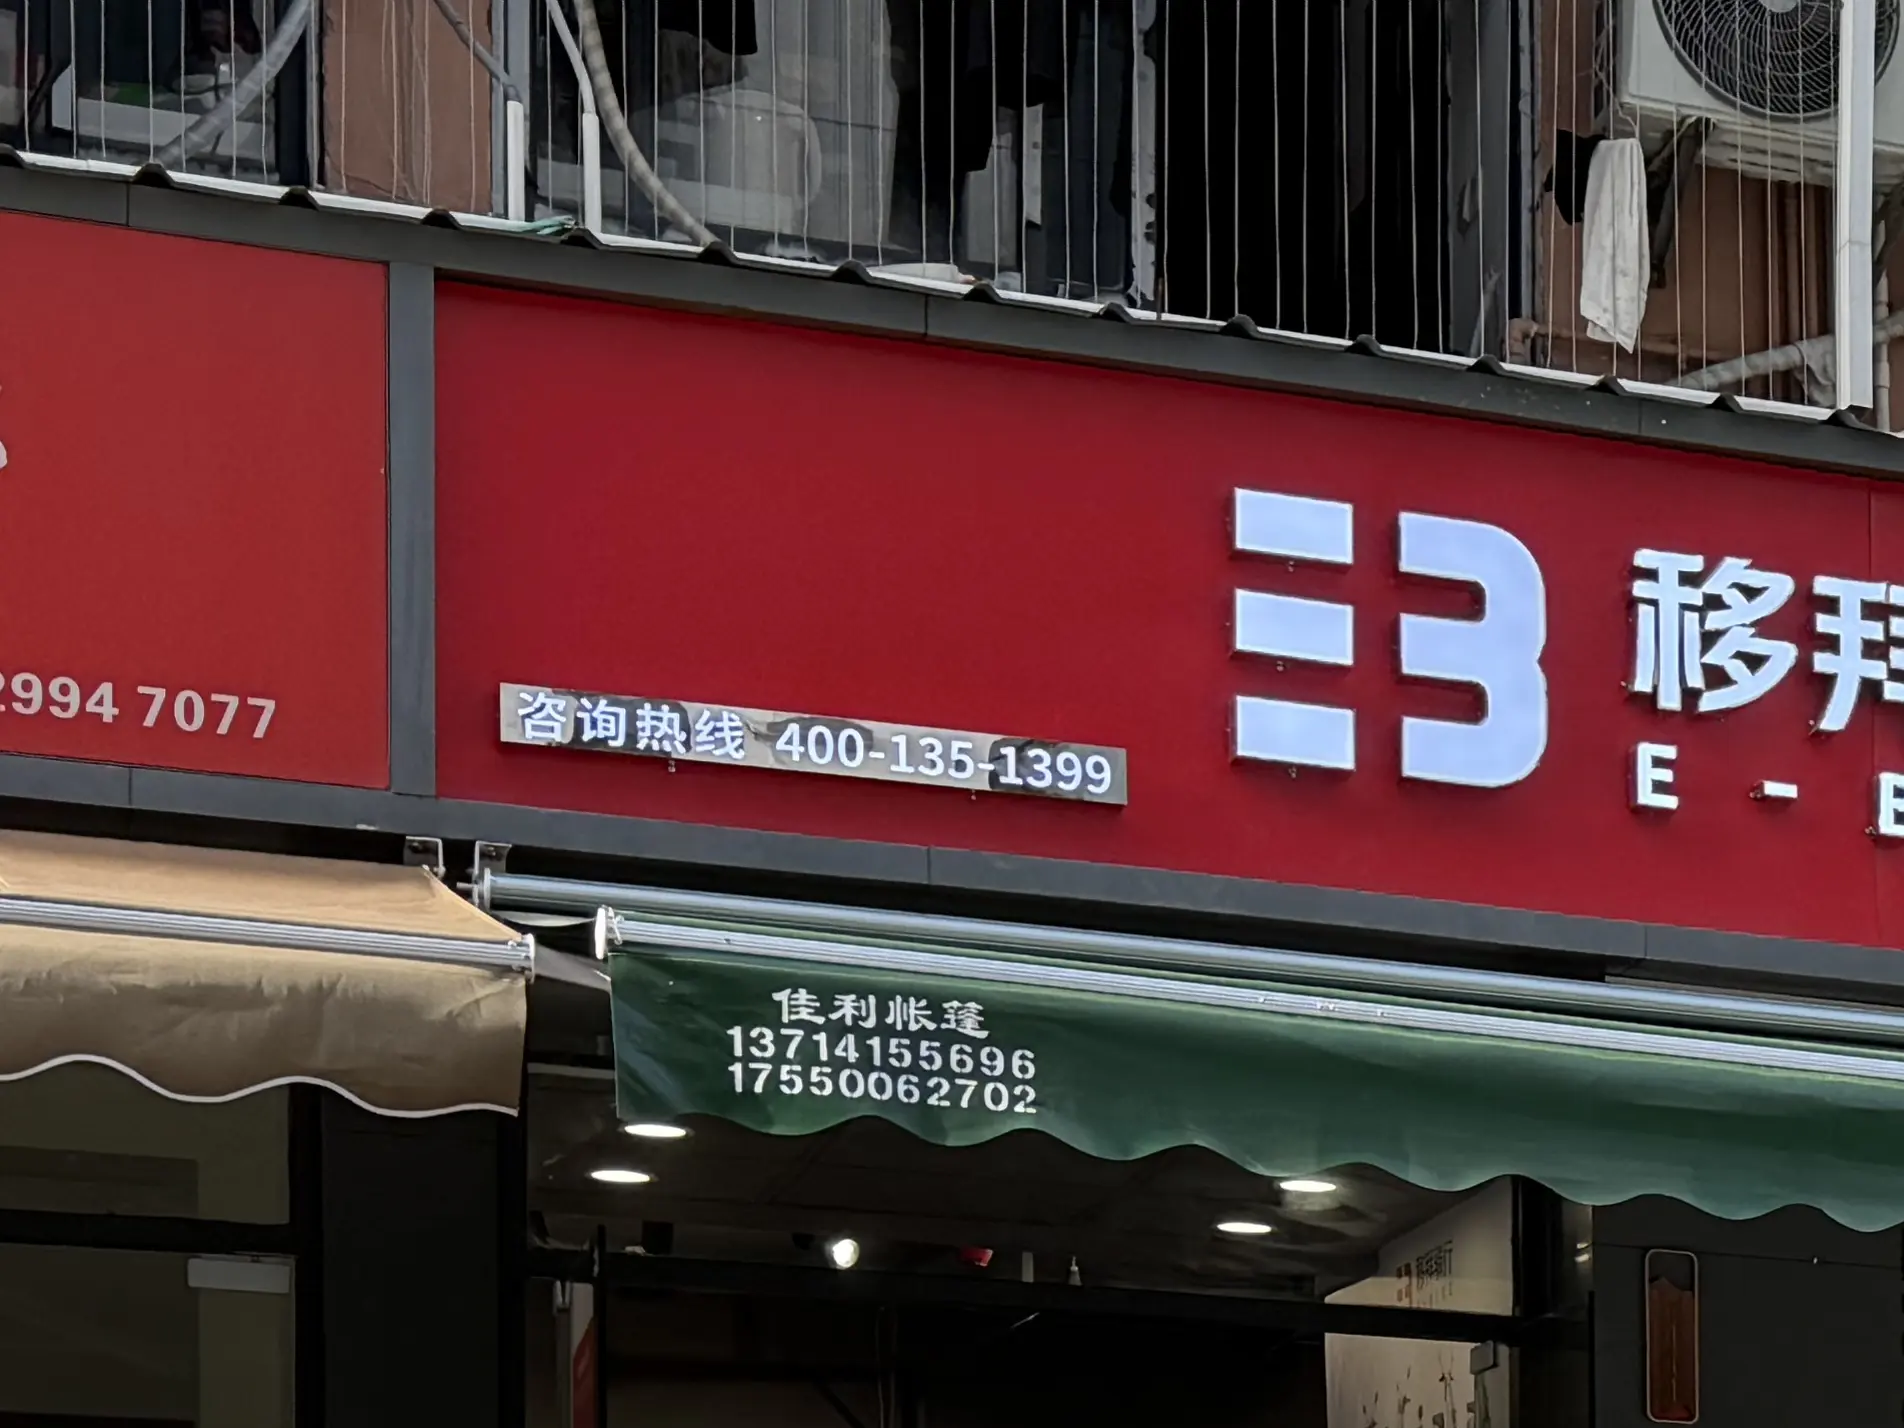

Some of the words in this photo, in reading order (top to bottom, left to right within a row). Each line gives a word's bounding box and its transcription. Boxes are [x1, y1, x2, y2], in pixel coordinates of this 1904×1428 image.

[0, 672, 119, 723] 994
[137, 686, 276, 738] 7077
[518, 692, 744, 758] 咨询热线
[777, 723, 1111, 794] 400-135-1399
[772, 989, 989, 1038] 佳利帐篷
[726, 1025, 1036, 1079] 13714155696
[729, 1062, 1036, 1114] 17550062702
